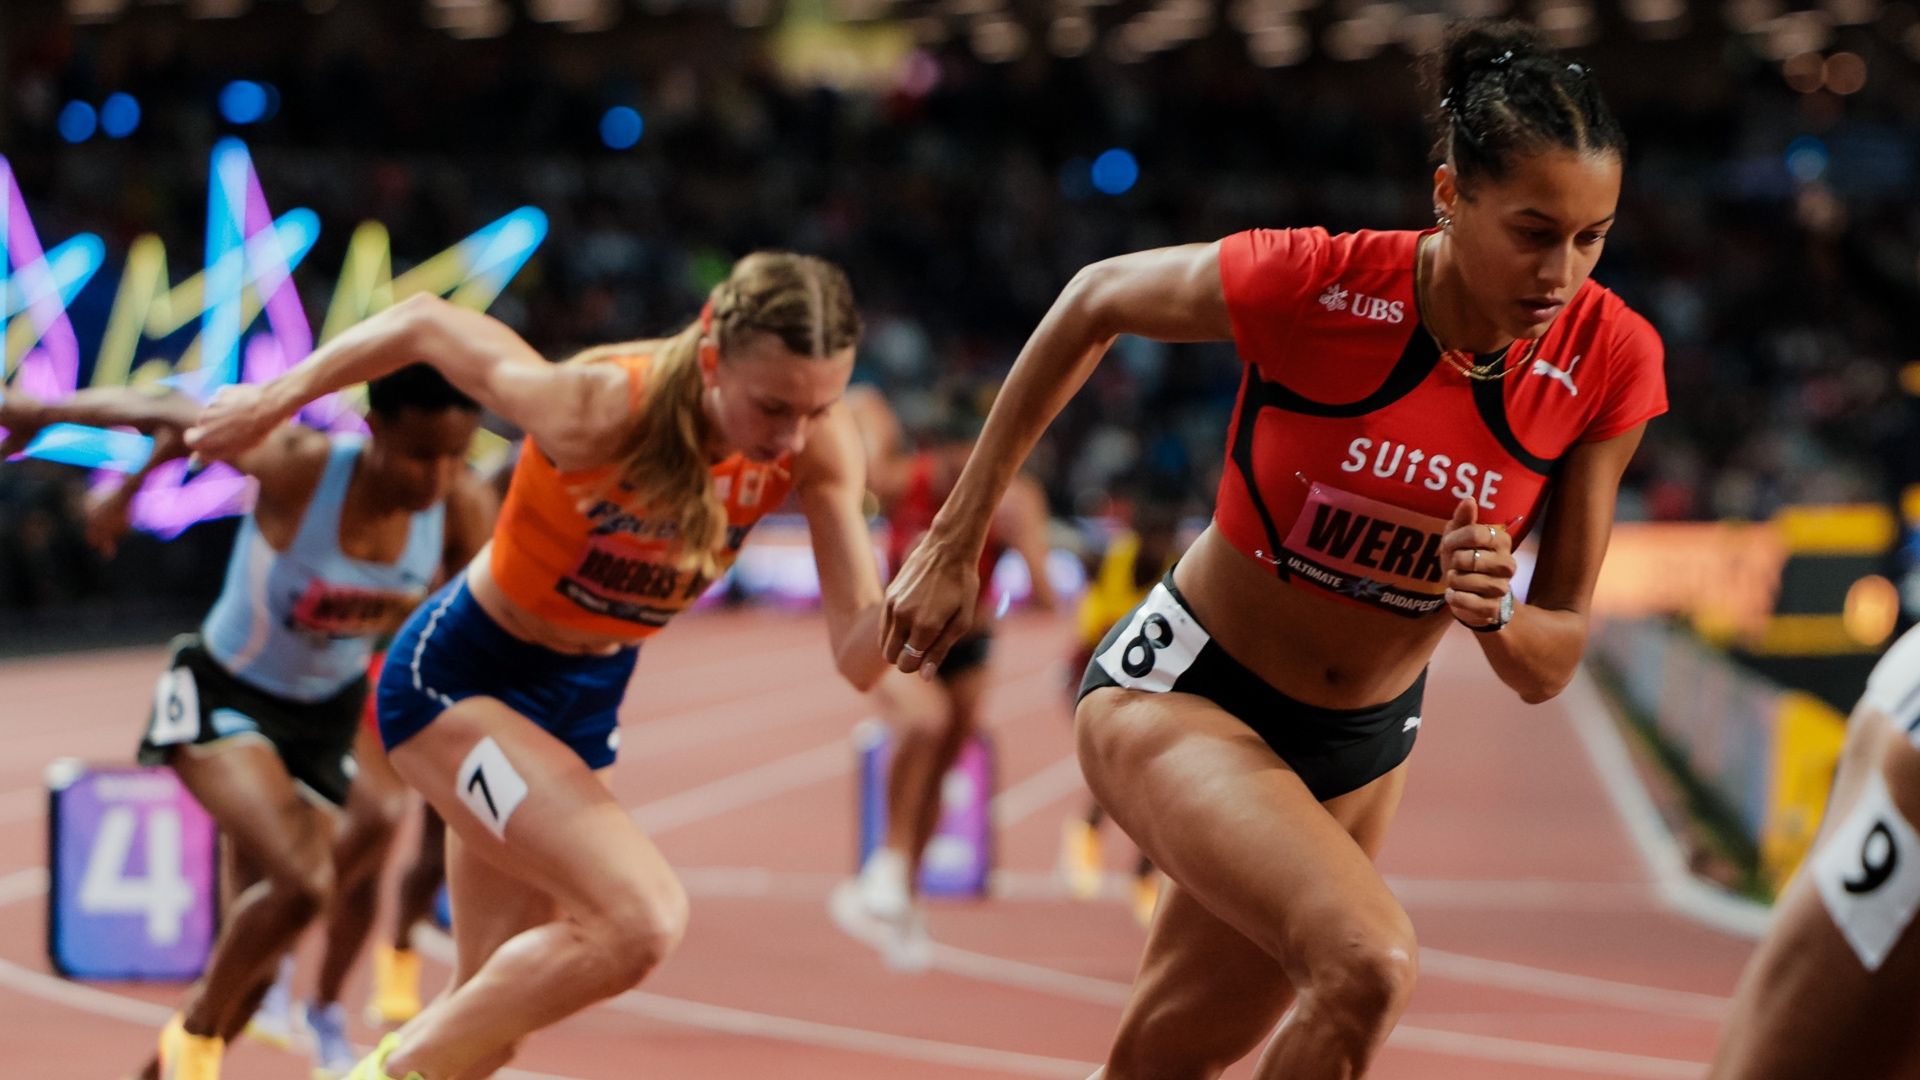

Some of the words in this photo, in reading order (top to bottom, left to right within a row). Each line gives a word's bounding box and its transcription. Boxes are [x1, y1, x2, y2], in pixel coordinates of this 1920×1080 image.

[1351, 292, 1405, 324] UBS
[1287, 556, 1343, 589] ULTIMATE
[1379, 591, 1442, 613] BUDAPEST
[1121, 612, 1174, 679] 8
[466, 763, 499, 821] 7
[77, 806, 195, 945] 4
[1842, 821, 1900, 894] 9
